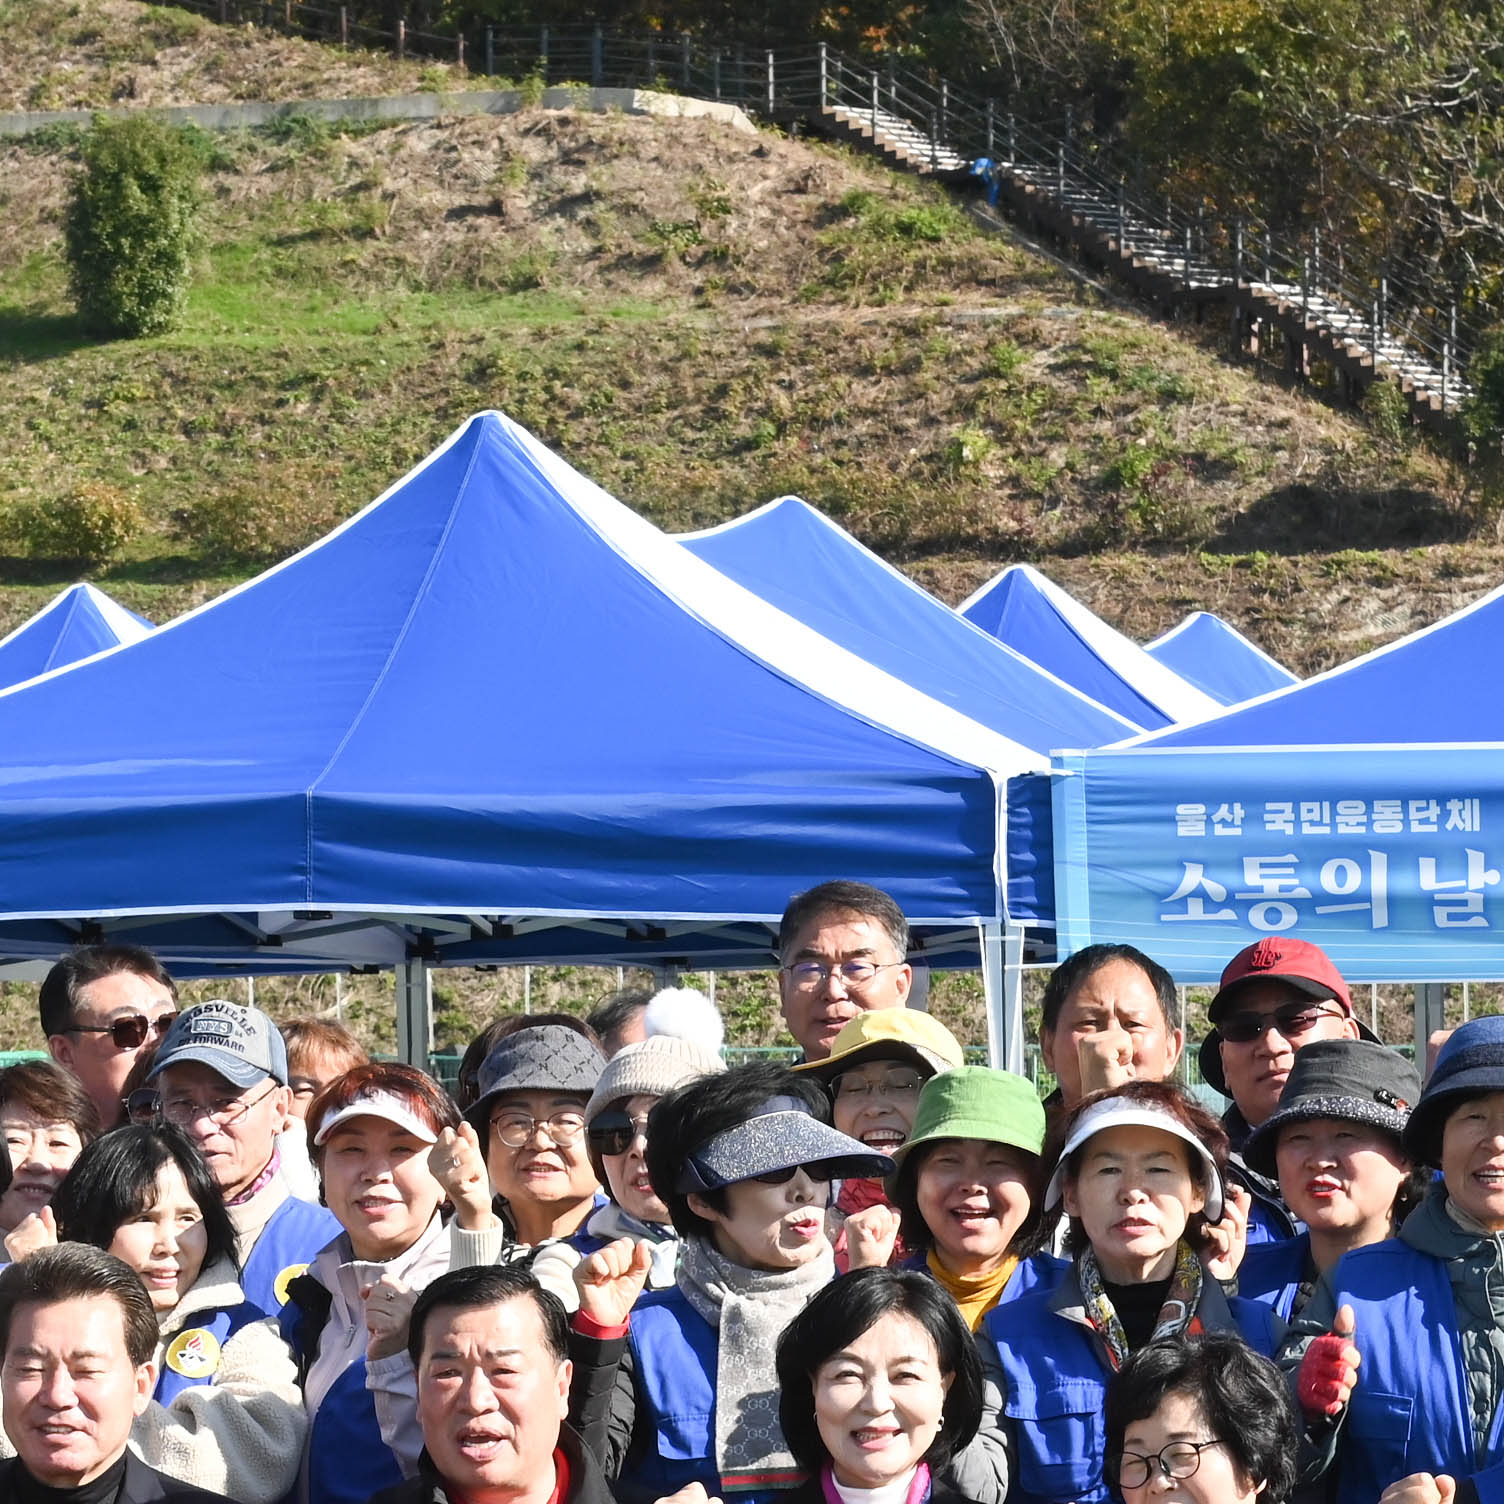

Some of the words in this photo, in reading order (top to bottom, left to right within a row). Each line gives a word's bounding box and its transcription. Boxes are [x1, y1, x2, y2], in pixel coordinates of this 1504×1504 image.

[1175, 802, 1245, 836] 울산
[1263, 798, 1481, 836] 국민운동단체
[1159, 848, 1389, 932] 소통의
[1418, 848, 1501, 928] 날
